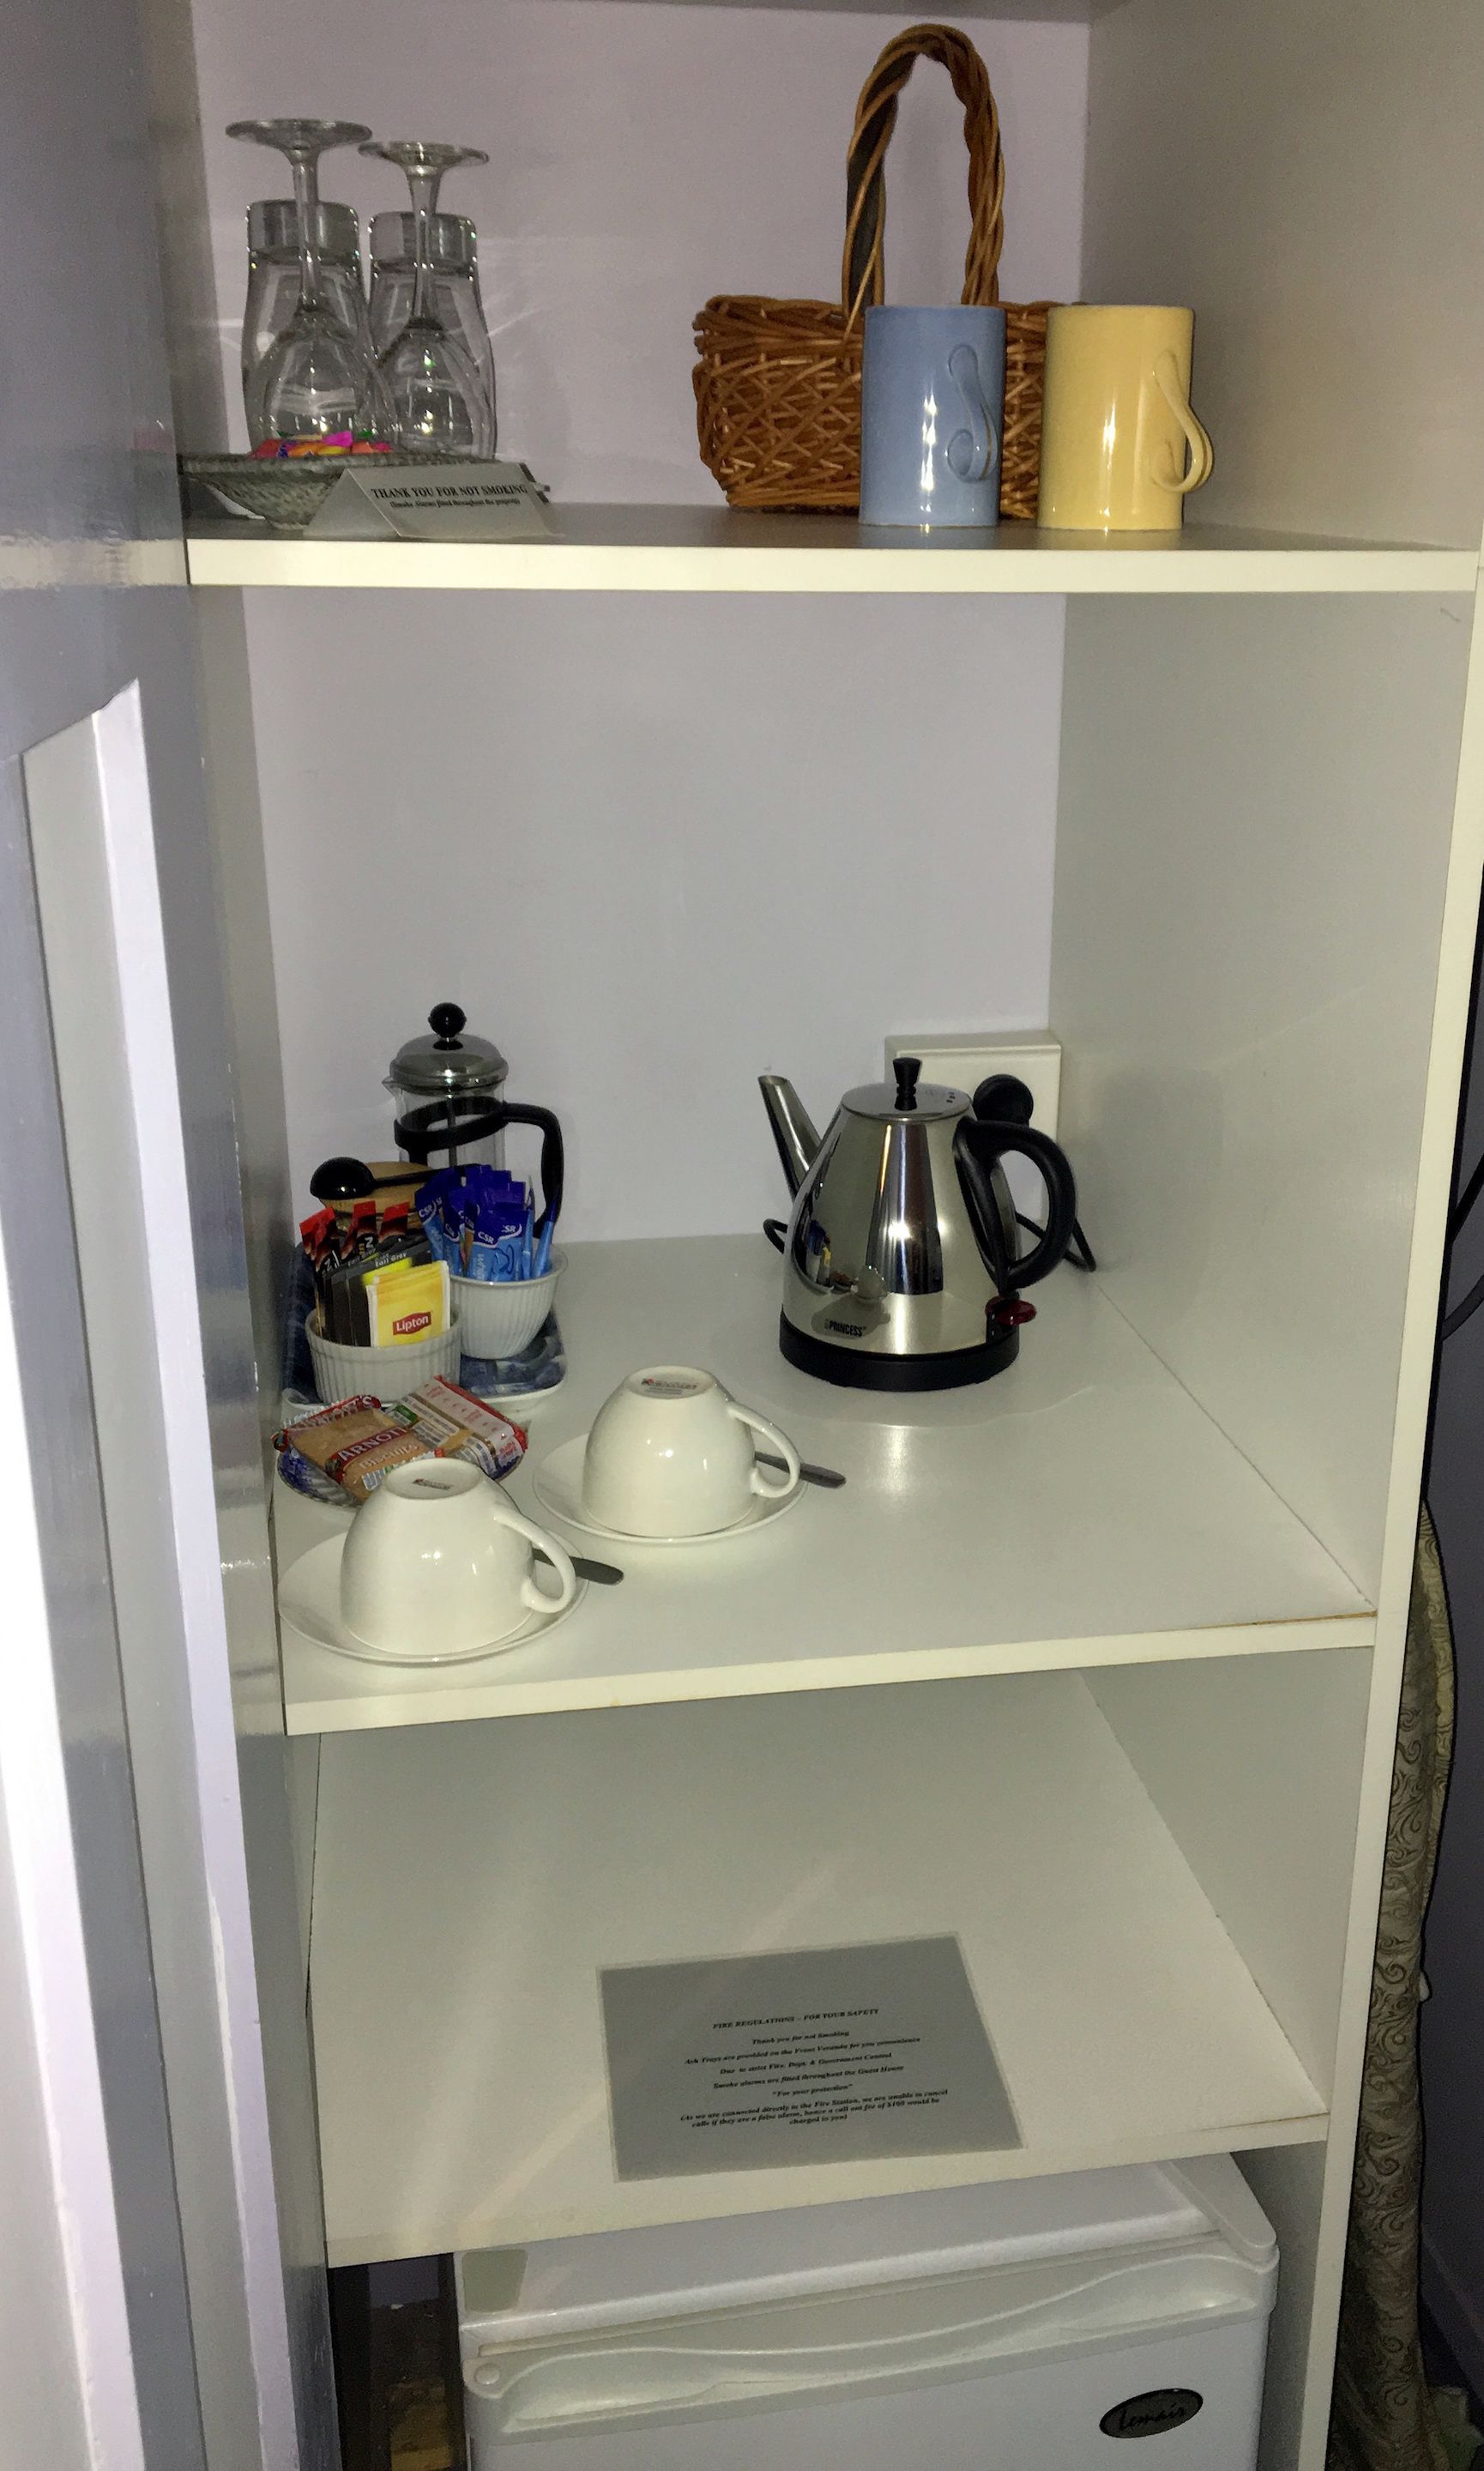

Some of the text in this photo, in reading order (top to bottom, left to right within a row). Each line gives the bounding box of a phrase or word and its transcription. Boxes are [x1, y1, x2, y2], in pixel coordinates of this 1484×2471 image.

[371, 484, 528, 498] THANK YOU FOR NOT SMOKING
[419, 1204, 433, 1217] CSR
[478, 1231, 494, 1245] CSR
[396, 1316, 429, 1332] Lipton
[829, 1320, 863, 1337] PRINCESS
[735, 2016, 795, 2027] REGULATIONS
